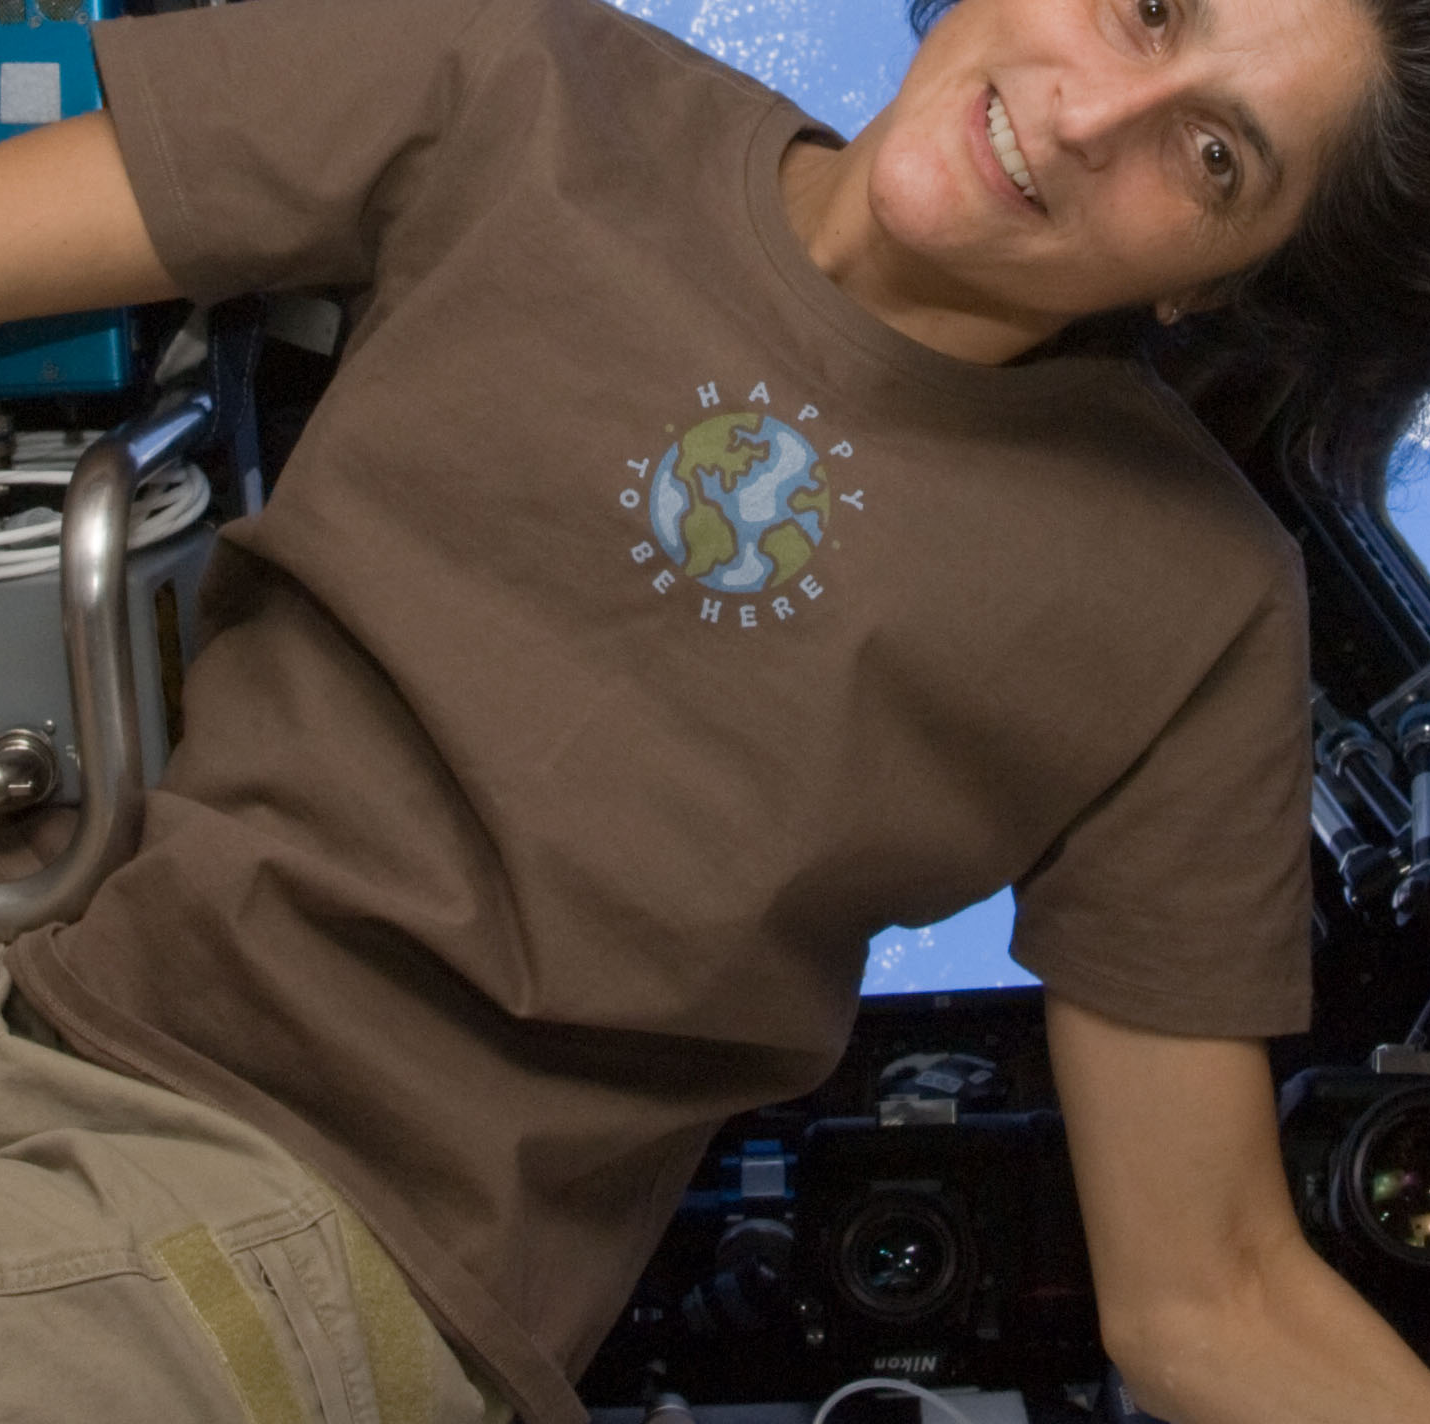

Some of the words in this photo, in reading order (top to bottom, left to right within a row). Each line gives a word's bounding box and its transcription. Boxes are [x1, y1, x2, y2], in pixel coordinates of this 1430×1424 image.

[696, 381, 865, 511] HAPPY
[619, 458, 650, 508] TO
[629, 541, 676, 595] BE
[700, 574, 824, 627] HERE
[873, 1356, 937, 1372] Nikon
